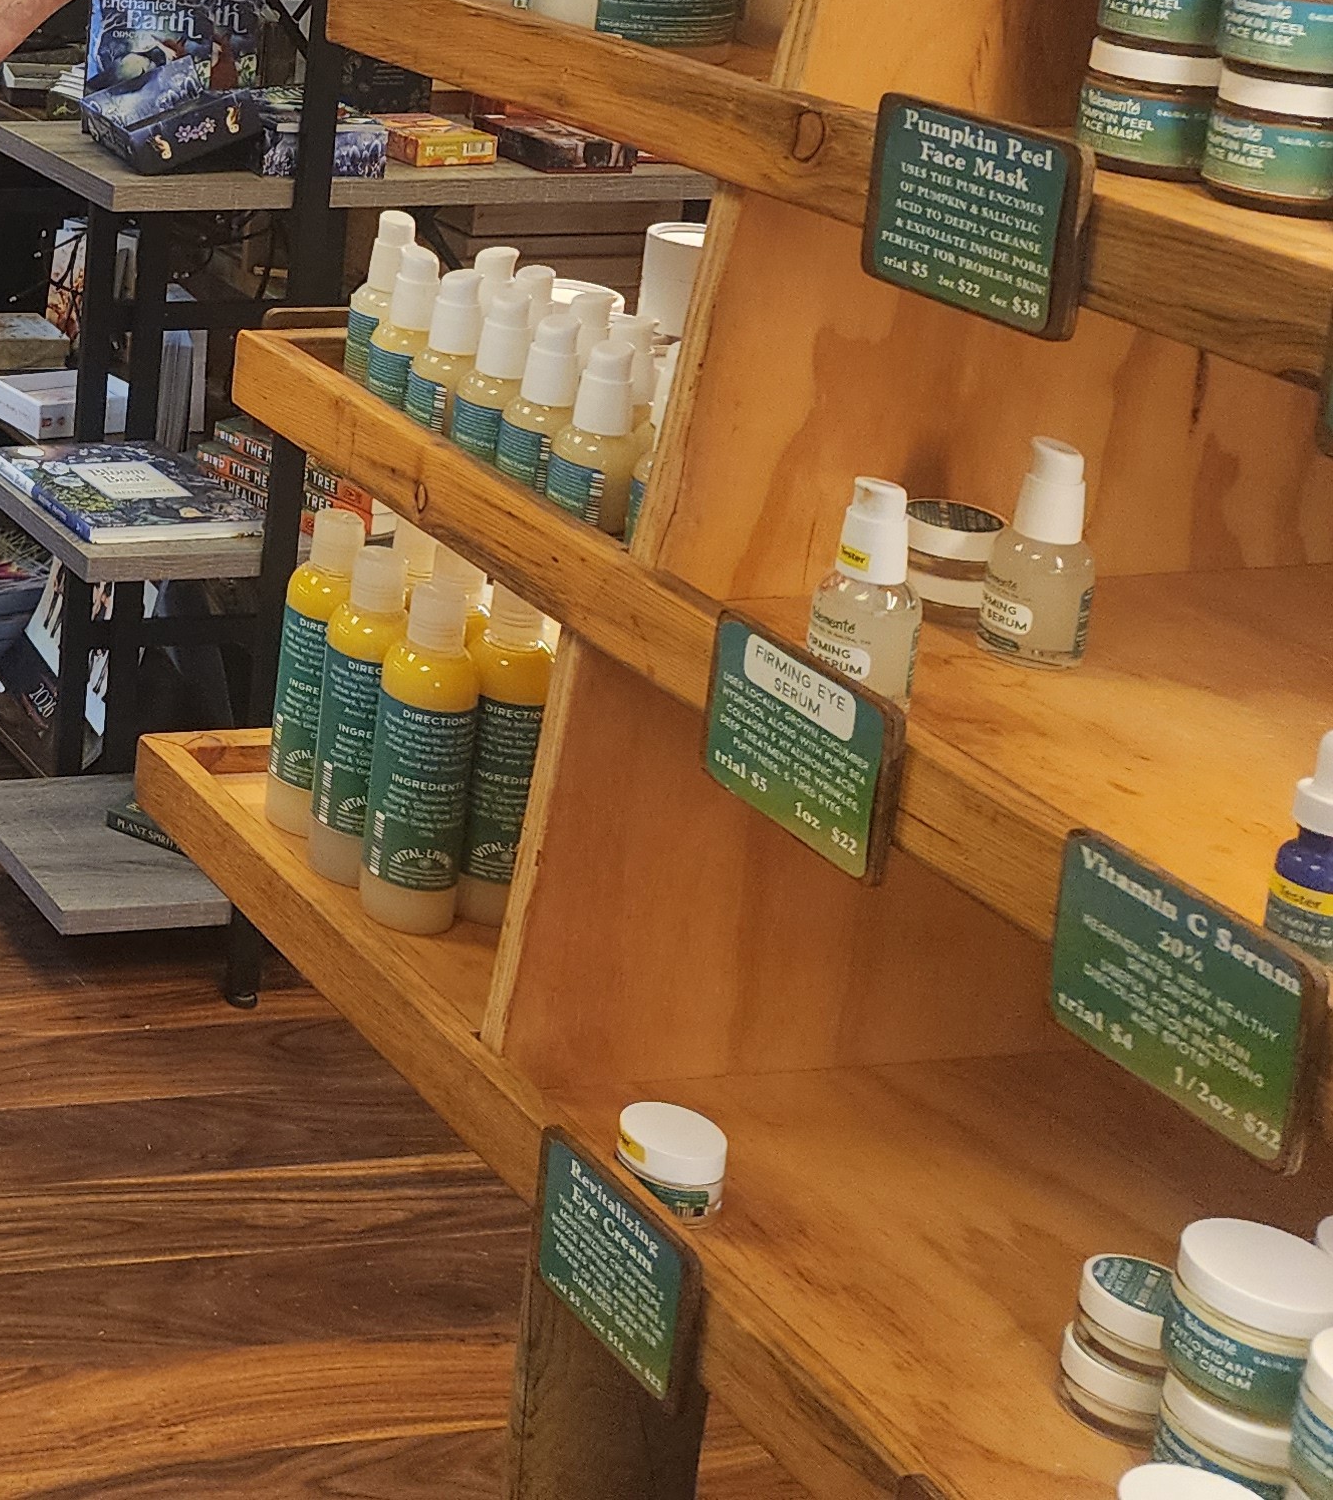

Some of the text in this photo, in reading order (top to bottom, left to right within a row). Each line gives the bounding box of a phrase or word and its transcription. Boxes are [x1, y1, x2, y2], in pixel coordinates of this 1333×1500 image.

[126, 7, 203, 40] Earth
[1132, 5, 1171, 21] MASK
[1270, 21, 1307, 37] PEEL
[1254, 30, 1293, 47] MASK
[903, 107, 1053, 171] Pumpkin Peel
[1106, 124, 1143, 142] MASK
[1121, 115, 1155, 131] PEEL
[919, 141, 1030, 191] Face Mask
[1227, 151, 1265, 170] MASK
[1248, 143, 1277, 160] PEEL
[899, 180, 1040, 235] OF PUMPKIN & SALICYLIC
[900, 161, 1044, 216] USES THE PURE ENZYMES
[894, 216, 1048, 277] & EXFOLIATE INSIDE PORES
[895, 197, 1041, 254] ACID TO DEEPLY CLEANSE
[881, 230, 1012, 283] PERFECT FOR PROBLEM
[883, 252, 1040, 319] trial $5 2oz $22 4oz $38
[219, 430, 240, 447] BIRD
[245, 440, 264, 459] THE
[203, 452, 225, 469] BIRD
[231, 462, 251, 481] THE
[312, 471, 336, 493] TREE
[305, 492, 333, 510] TREE
[988, 608, 1028, 632] SERUM
[29, 683, 57, 718] 2026
[756, 647, 845, 711] FIRMING EYE
[774, 679, 820, 715] SERUM
[719, 713, 811, 779] DEEP TREATMENT FOR
[723, 688, 865, 784] HYDROSOL ALONG WITH PURE SEA
[726, 704, 768, 735] COLLAGEN
[780, 740, 831, 776] HYALURONIC
[746, 687, 781, 714] LOCALLY
[784, 711, 817, 737] GROWN
[821, 735, 869, 769] CUCUMBER
[715, 747, 857, 855] trial $5 1oz $22
[793, 778, 815, 798] TIRED
[115, 816, 146, 837] PLANT
[1080, 850, 1301, 993] Vitamin C Serum
[1158, 930, 1204, 971] 20%
[1217, 999, 1278, 1042] HEALTHY
[1057, 989, 1280, 1150] trial 1/2oz $22
[1192, 1035, 1263, 1086] INCLUDING
[570, 1158, 660, 1258] Revitalizing
[571, 1186, 653, 1272] Eye Cream
[1199, 1359, 1252, 1392] CREAM
